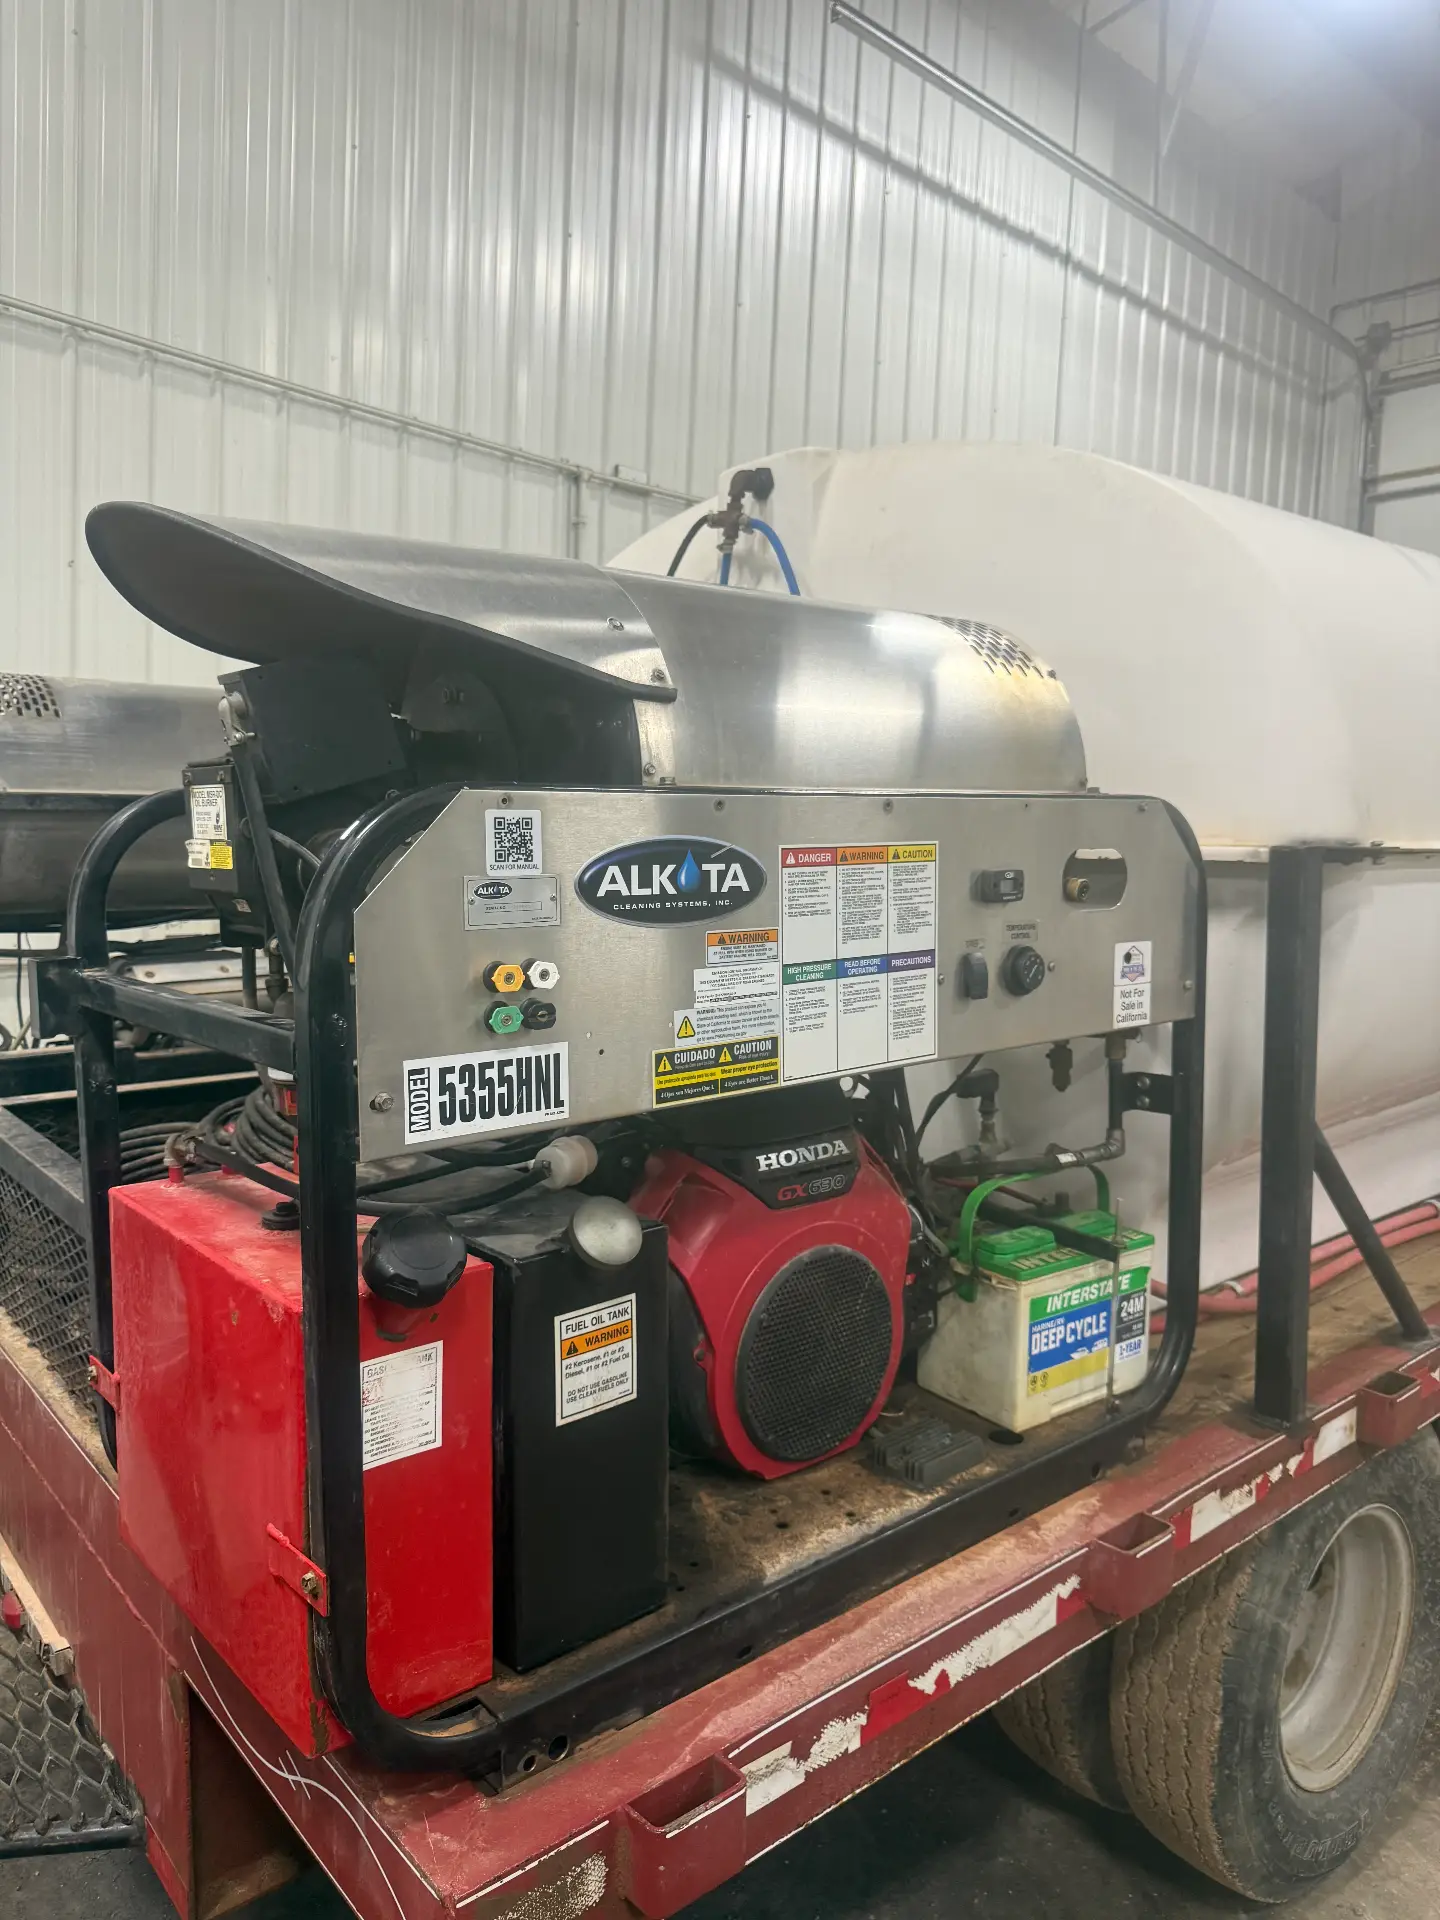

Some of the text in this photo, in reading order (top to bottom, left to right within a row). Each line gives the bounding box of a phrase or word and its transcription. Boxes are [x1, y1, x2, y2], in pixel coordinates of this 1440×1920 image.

[798, 853, 832, 864] DANGER
[850, 851, 885, 861] WARNING
[902, 849, 933, 859] CAUTION
[613, 902, 661, 910] CLEANING
[665, 900, 711, 909] SYSTEMS,
[728, 932, 770, 944] WARNING
[860, 958, 881, 966] BEFORE
[892, 956, 932, 967] PRECAUTIONS
[788, 963, 832, 975] HIGH PRESSURE
[848, 966, 878, 976] OPERATING
[796, 972, 824, 982] CLEANING
[1120, 988, 1145, 1000] Not For
[1121, 1000, 1143, 1012] Sale in
[1116, 1012, 1148, 1024] California
[734, 1040, 772, 1055] CAUTION
[674, 1049, 716, 1064] CUIDADO
[732, 1066, 747, 1074] proper
[755, 1062, 778, 1071] protection
[439, 1053, 565, 1126] 5355HNL
[684, 1088, 701, 1096] Mejores
[409, 1068, 430, 1132] MODEL
[756, 1140, 851, 1172] HONDA
[1121, 1295, 1145, 1319] 24M
[565, 1306, 630, 1335] FUEL OIL TANK
[1032, 1316, 1066, 1333] MARINE/RV
[585, 1325, 630, 1348] WARNING
[1031, 1312, 1108, 1356] DEEP CYCLE
[565, 1363, 573, 1371] #2
[574, 1354, 602, 1369] Kerosene,
[603, 1351, 610, 1359] #1
[618, 1346, 625, 1354] #2
[565, 1370, 585, 1380] Diesel,
[601, 1360, 609, 1368] #2
[609, 1356, 621, 1365] Fuel
[622, 1352, 630, 1360] Oil
[567, 1371, 628, 1397] DO NOT USE GASOLINE
[566, 1395, 578, 1404] USE
[579, 1389, 597, 1400] CLEAN
[598, 1382, 615, 1393] FUELS
[616, 1378, 630, 1387] ONLY
